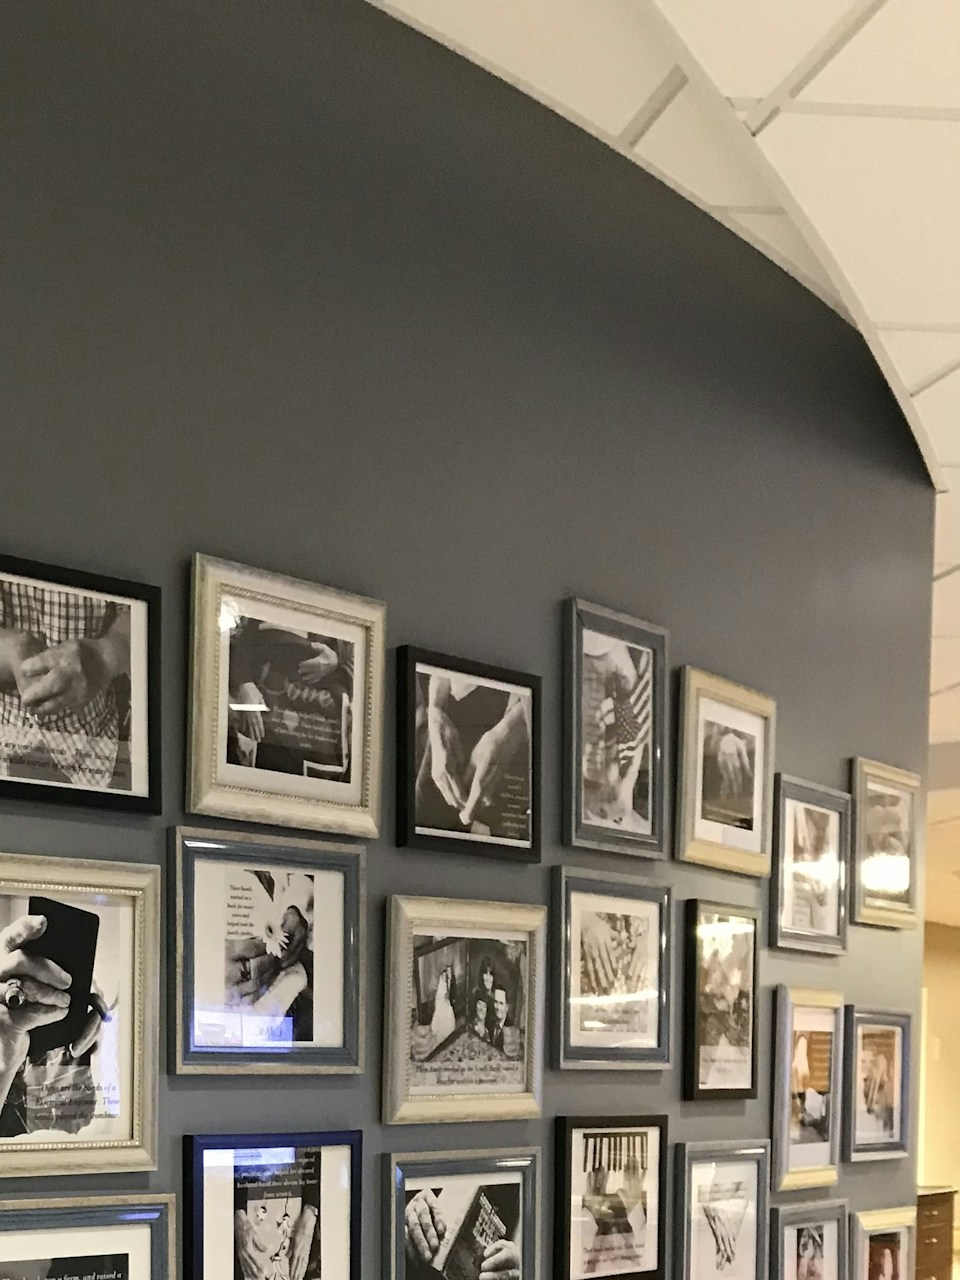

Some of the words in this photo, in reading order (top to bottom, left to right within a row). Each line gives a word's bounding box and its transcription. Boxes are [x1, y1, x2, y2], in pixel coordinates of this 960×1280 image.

[83, 1272, 96, 1280] and
[97, 1271, 116, 1280] raised
[116, 1271, 122, 1279] a
